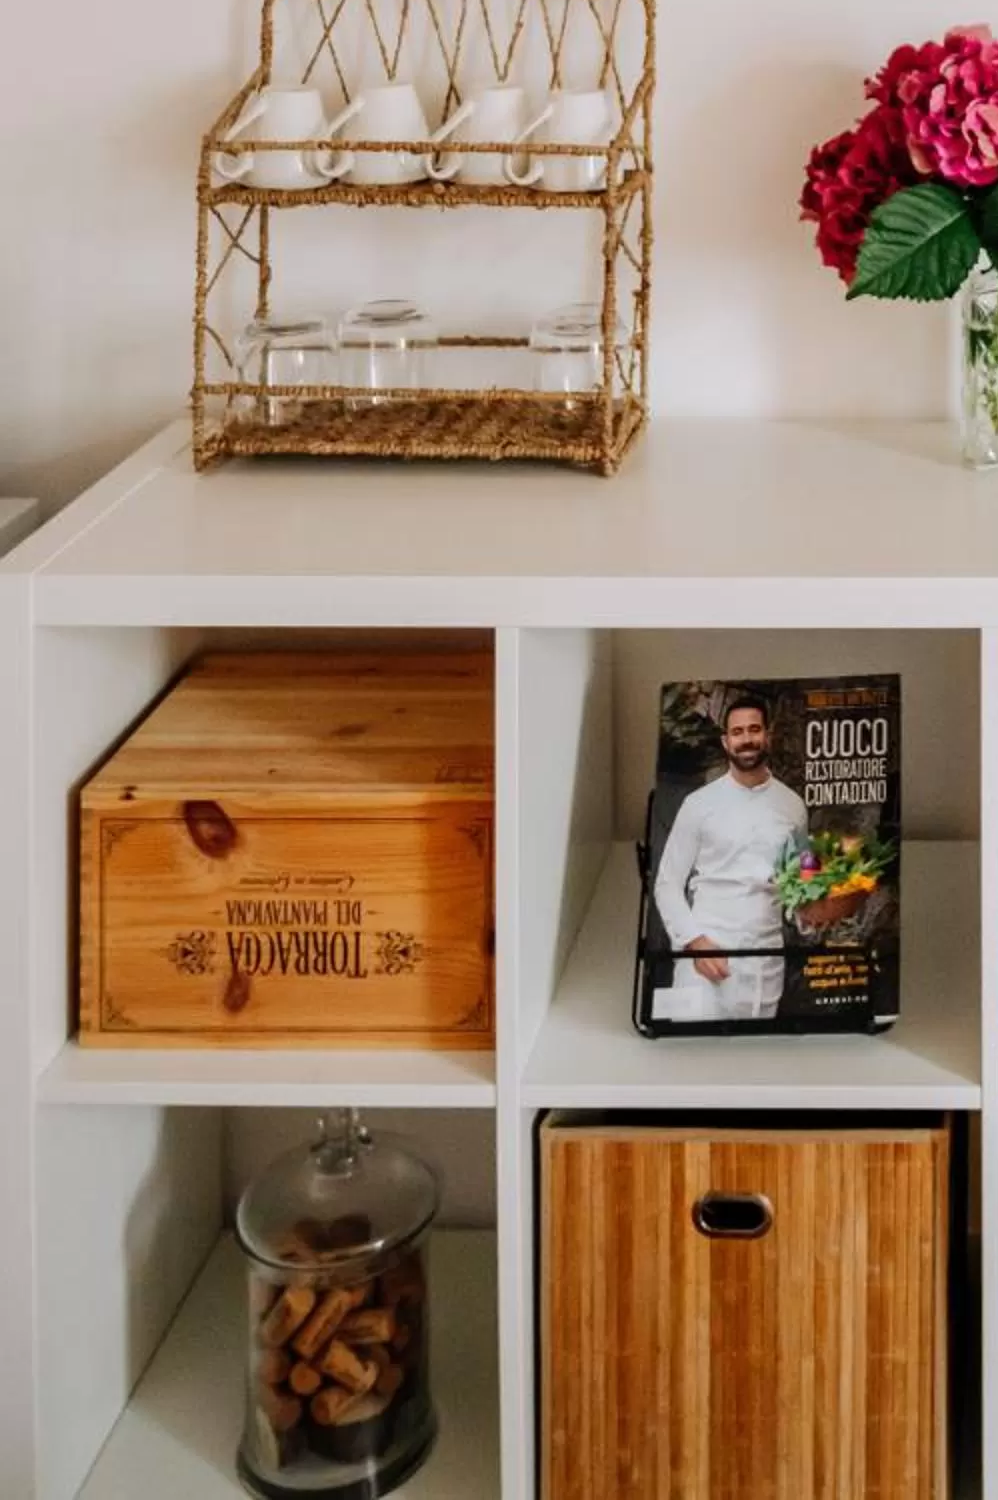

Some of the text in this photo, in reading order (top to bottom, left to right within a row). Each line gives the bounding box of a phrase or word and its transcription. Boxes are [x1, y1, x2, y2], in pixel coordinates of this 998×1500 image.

[806, 718, 888, 759] CUOCO
[805, 758, 888, 781] RISTORATORE
[805, 780, 887, 807] CONTADINO
[335, 900, 362, 926] DEL
